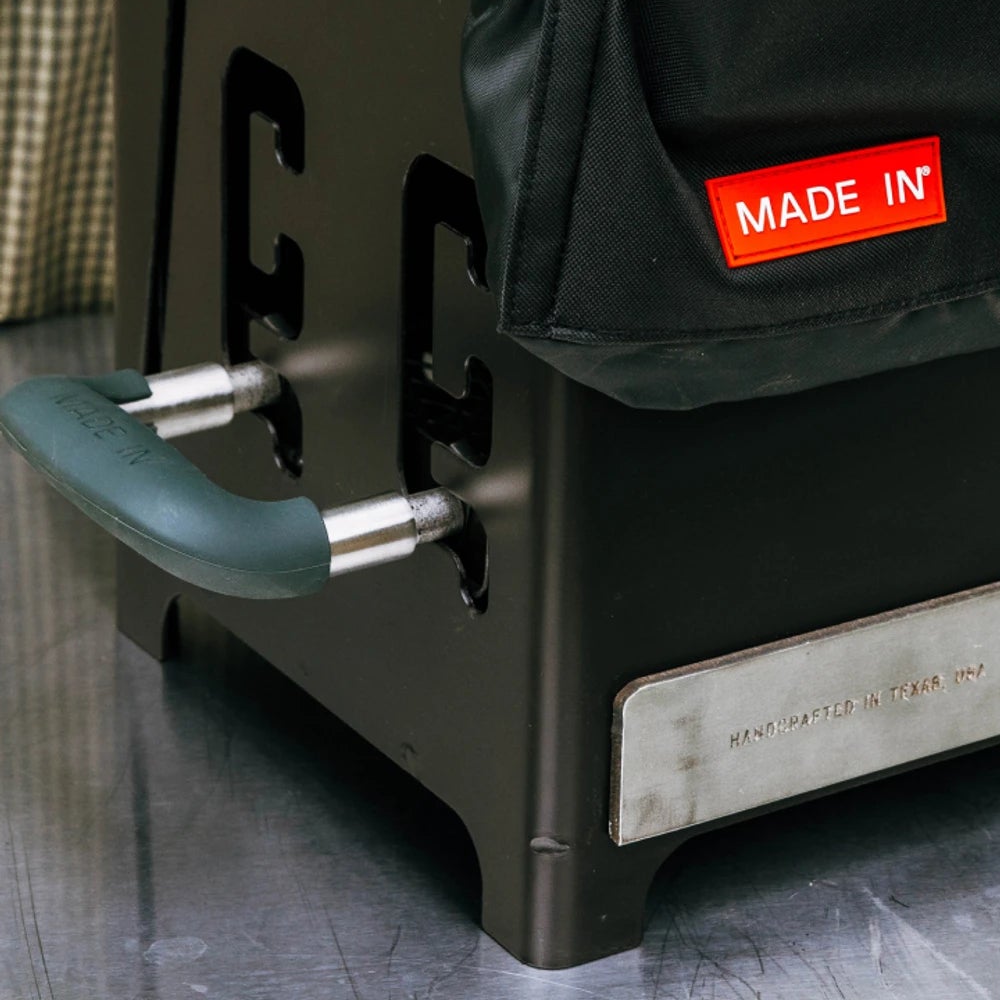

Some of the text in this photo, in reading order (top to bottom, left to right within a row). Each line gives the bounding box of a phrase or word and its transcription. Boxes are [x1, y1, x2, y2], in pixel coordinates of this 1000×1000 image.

[735, 179, 861, 235] MADE
[730, 699, 855, 748] HANDCRAFTED
[863, 690, 882, 710] IN
[954, 663, 986, 685] USA
